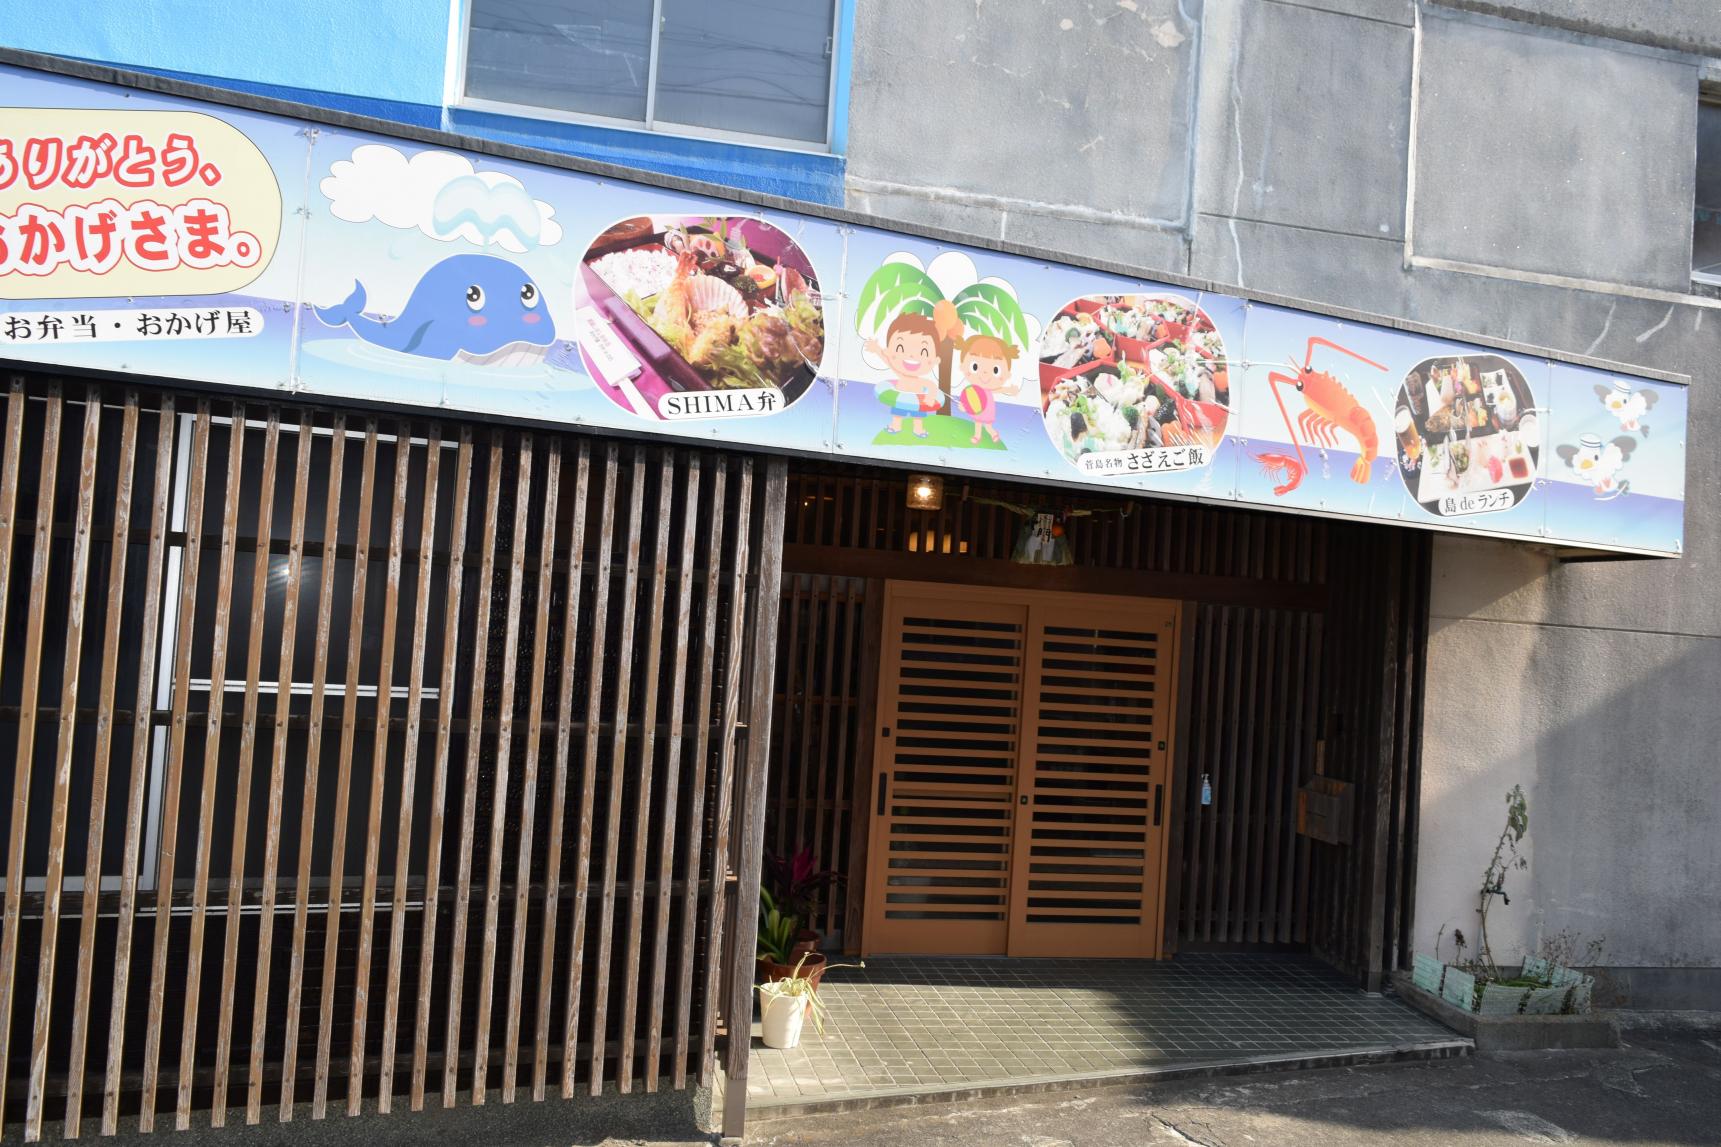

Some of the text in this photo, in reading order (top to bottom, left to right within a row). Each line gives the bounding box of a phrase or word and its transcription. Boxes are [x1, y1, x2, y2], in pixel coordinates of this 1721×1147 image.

[0, 207, 252, 266] かげさま。
[4, 310, 252, 340] お弁当・おかげ屋
[1127, 448, 1204, 470] さざえご飯
